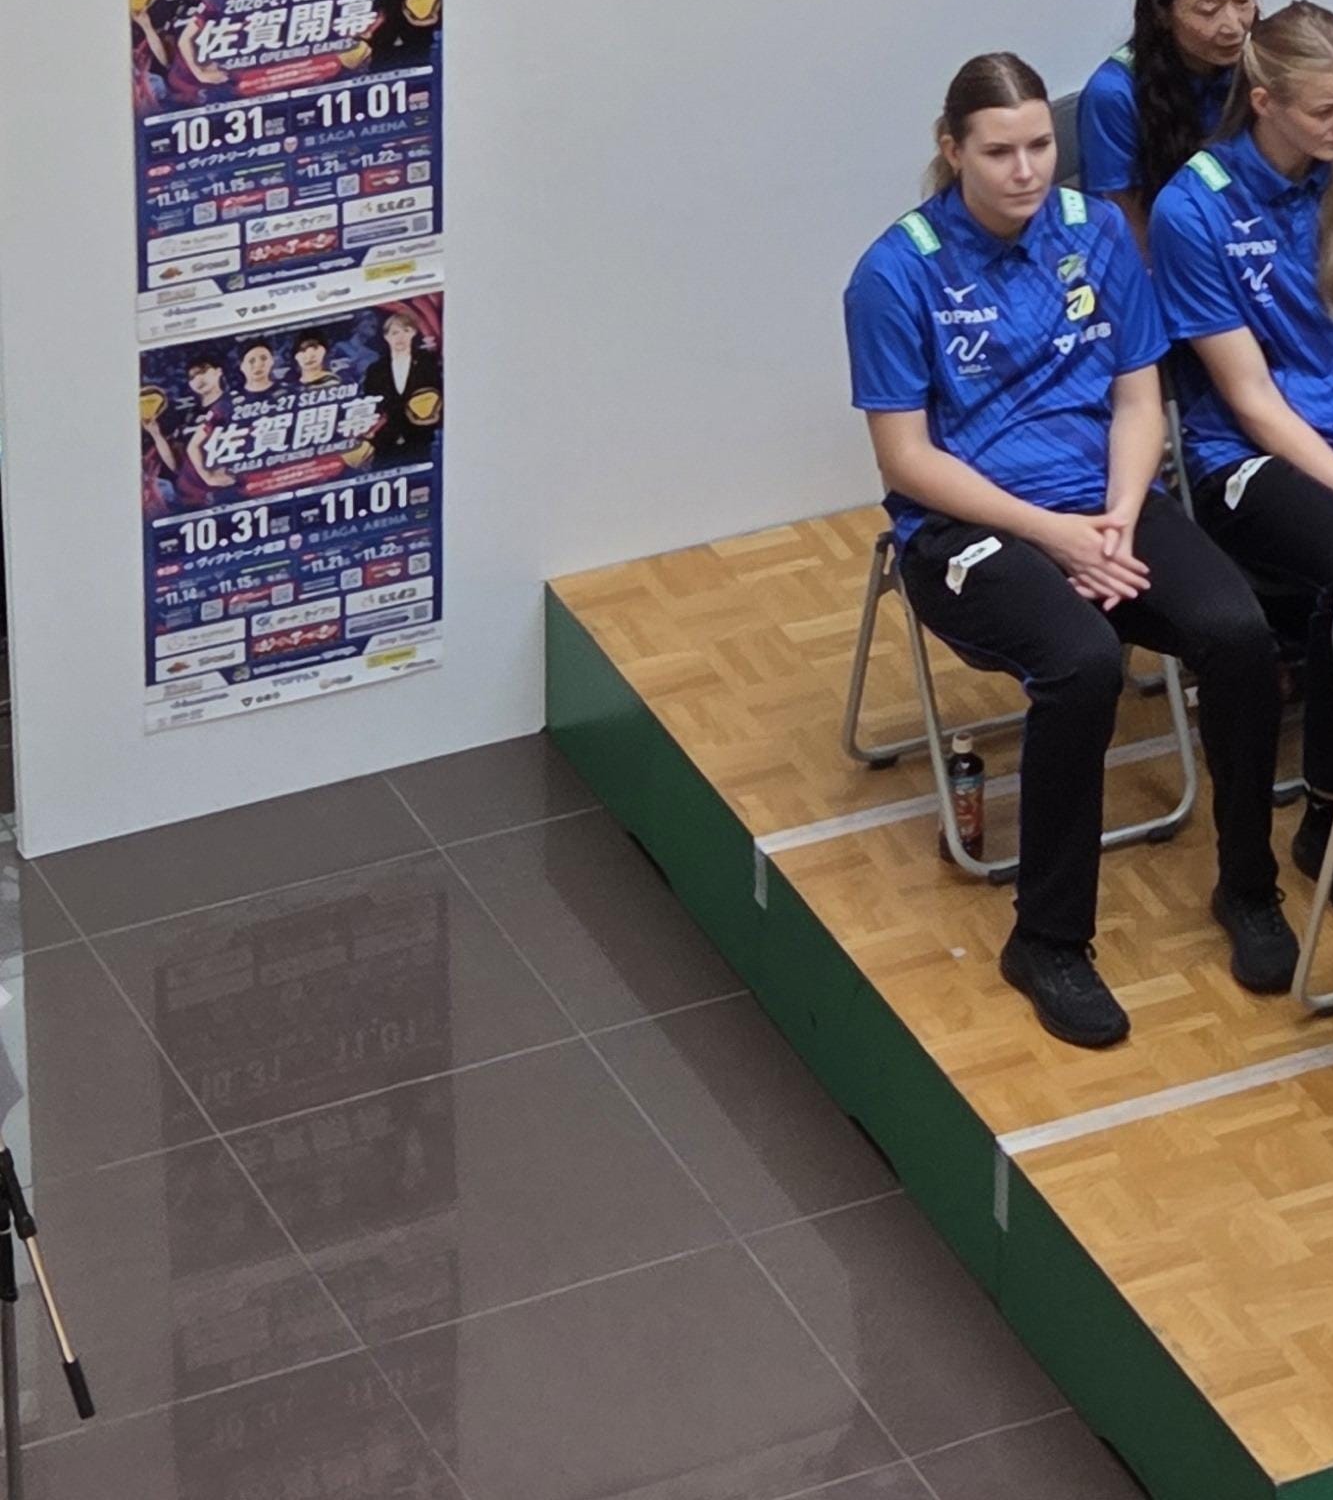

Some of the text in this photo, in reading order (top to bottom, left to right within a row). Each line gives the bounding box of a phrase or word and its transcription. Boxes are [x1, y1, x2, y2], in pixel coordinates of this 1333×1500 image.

[317, 80, 407, 127] 11.01
[172, 106, 264, 154] 10.31
[232, 383, 358, 420] 2026-27 SEASON
[205, 395, 383, 467] 佐賀開幕
[321, 477, 408, 524] 11.01
[180, 506, 270, 554] 10.31
